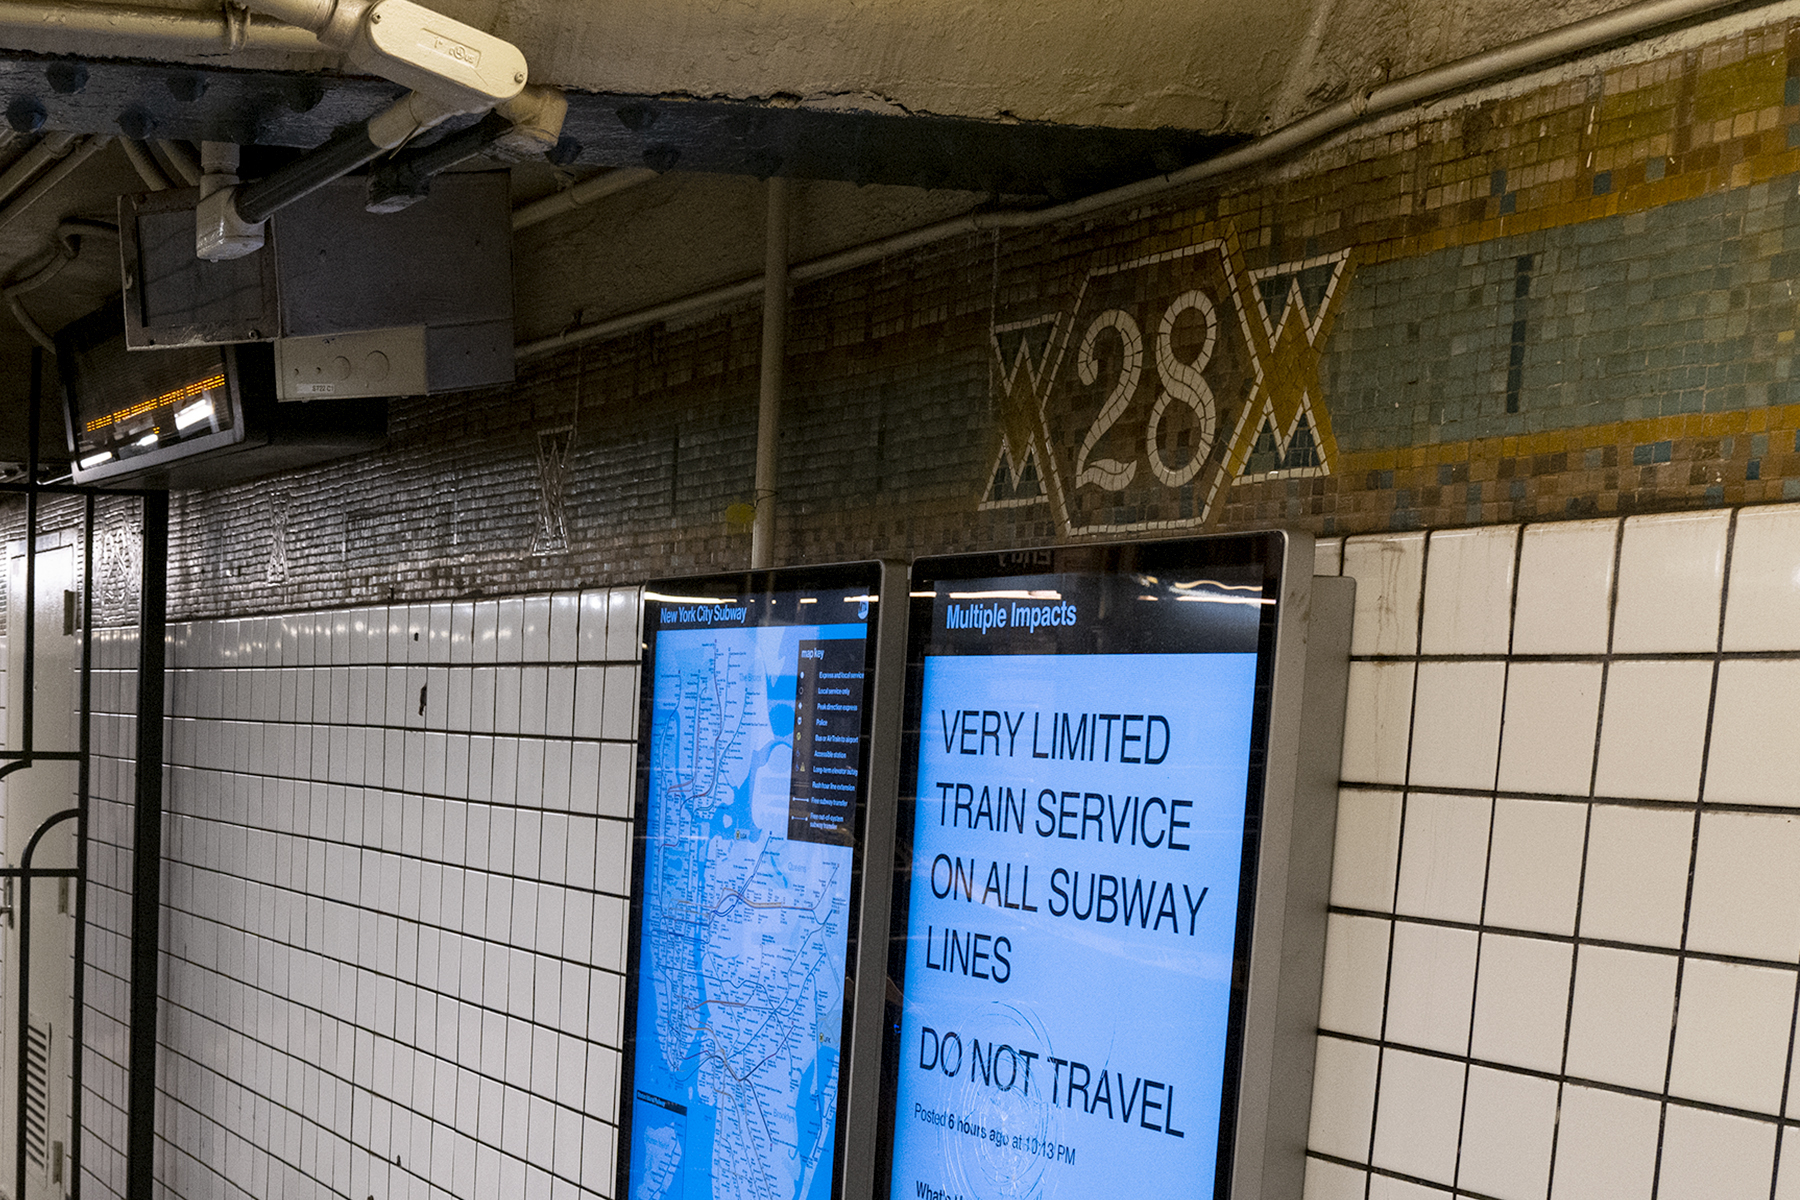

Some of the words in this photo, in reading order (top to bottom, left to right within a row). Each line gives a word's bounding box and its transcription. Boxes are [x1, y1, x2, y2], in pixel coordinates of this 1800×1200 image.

[1076, 289, 1217, 491] 28
[660, 607, 678, 623] New
[679, 606, 696, 623] York
[696, 606, 714, 625] City
[714, 605, 747, 624] Subway
[946, 603, 1007, 635] Multiple
[1010, 601, 1077, 634] Impacts
[801, 650, 814, 660] map
[814, 647, 825, 660] key
[942, 710, 1025, 757] VERY
[1032, 711, 1170, 766] LIMITED
[936, 782, 1026, 834] TRAIN
[1035, 788, 1194, 851] SERVICE
[931, 853, 974, 903] ON
[981, 861, 1038, 912] ALL
[1048, 868, 1209, 936] SUBWAY
[926, 925, 1012, 984] LINES
[919, 1026, 963, 1077] DO
[971, 1038, 1039, 1096] NOT
[1047, 1056, 1185, 1139] TRAVEL
[914, 1102, 946, 1127] Posted
[948, 1113, 956, 1130] 6
[957, 1115, 987, 1140] hours
[989, 1128, 1010, 1148] ago
[1012, 1134, 1023, 1150] at
[1024, 1136, 1055, 1160] 10:13
[1056, 1144, 1076, 1166] PM
